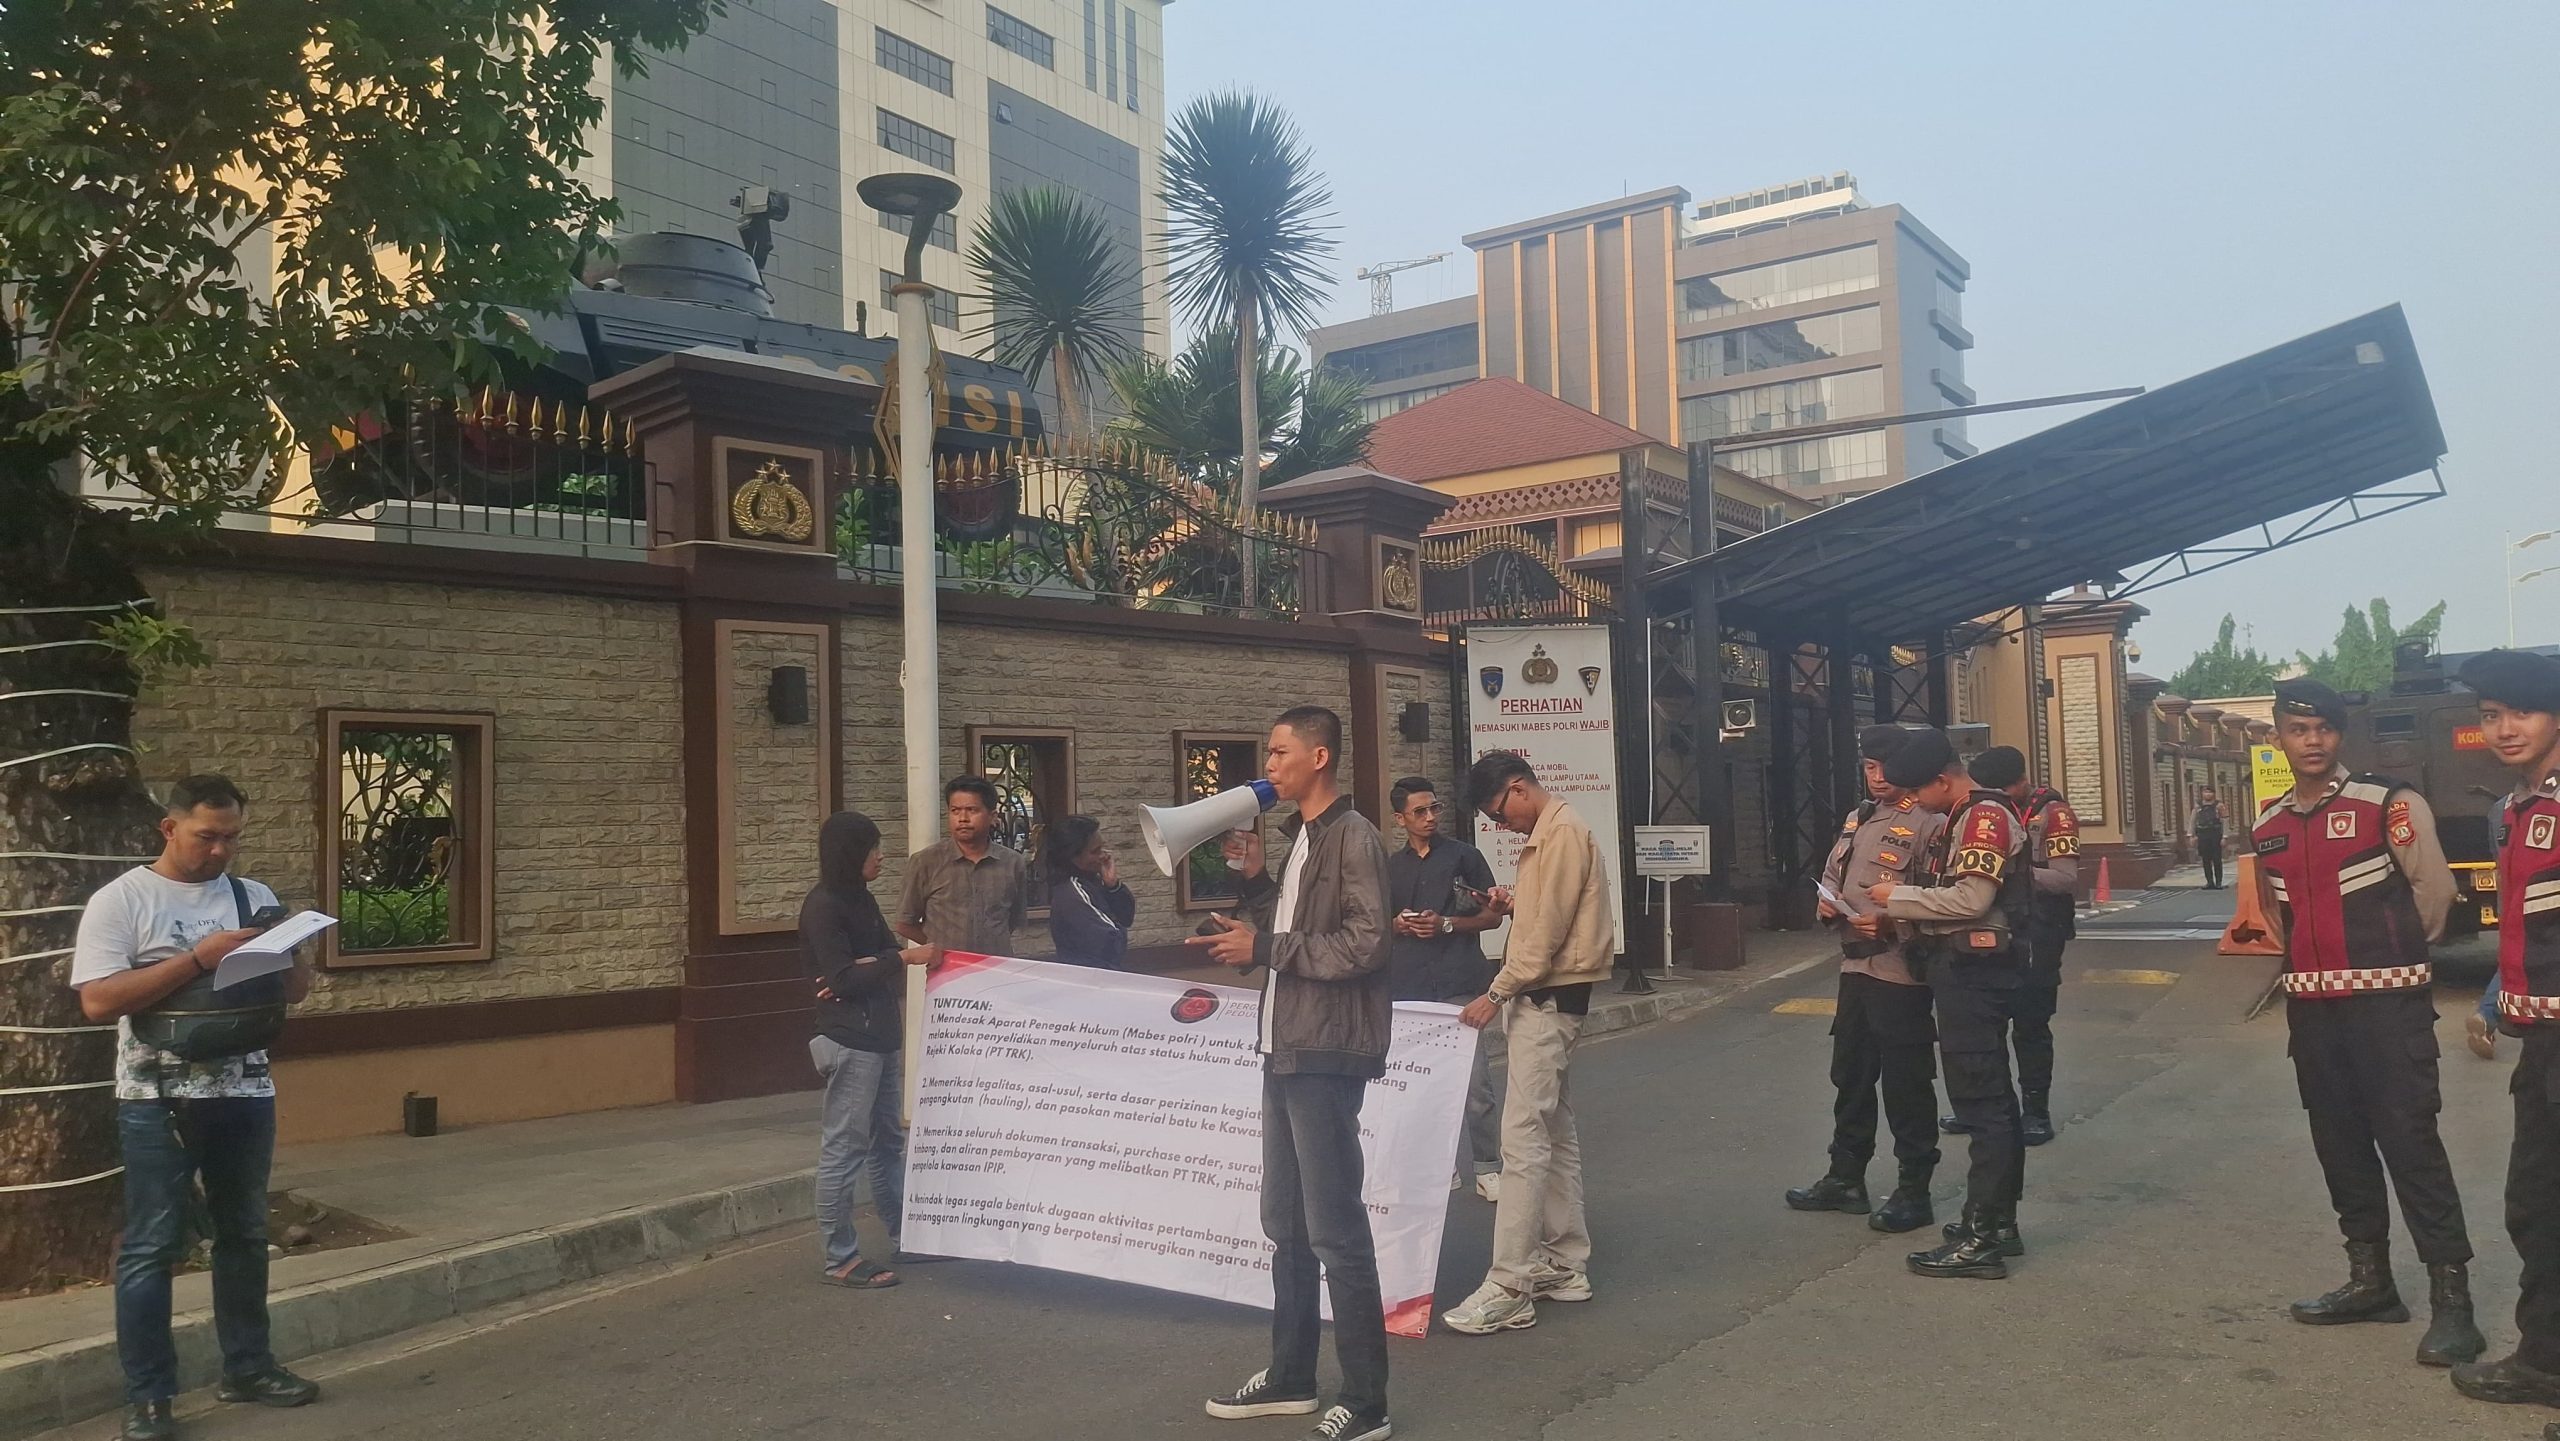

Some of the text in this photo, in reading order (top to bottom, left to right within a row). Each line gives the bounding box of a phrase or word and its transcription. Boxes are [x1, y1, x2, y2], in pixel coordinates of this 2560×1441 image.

[1501, 698, 1583, 713] PERHATIAN
[1474, 720, 1609, 733] MEMASUKI MABES POLRI WAJIB
[2458, 732, 2486, 744] KOR
[1561, 784, 1584, 792] LAMPU
[1481, 823, 1491, 832] 2.
[1881, 835, 1911, 850] POLRI
[933, 998, 993, 1012] TUNTUTAN:
[1224, 1009, 1257, 1018] PEDUL
[1230, 1001, 1259, 1010] PERG
[926, 1044, 1035, 1062] Rejeki Kolaka (PT TRK).
[928, 1028, 975, 1041] melakukan
[976, 1030, 1047, 1046] penyelidikan
[1049, 1038, 1118, 1053] menyeluruh
[1121, 1043, 1146, 1056] atas
[1149, 1047, 1186, 1060] status
[1188, 1052, 1231, 1066] hukum
[1234, 1055, 1259, 1068] dan
[936, 1014, 986, 1026] Mendesak
[987, 1016, 1027, 1029] Aparat
[1028, 1018, 1077, 1034] Penegak
[1078, 1022, 1120, 1037] Hukum
[1122, 1026, 1166, 1042] (Mabes
[1167, 1033, 1199, 1045] polri
[1208, 1038, 1245, 1050] untuk
[1405, 1061, 1431, 1076] dan
[928, 1075, 974, 1088] Memeriksa
[975, 1077, 1025, 1093] legalitas,
[1028, 1083, 1083, 1099] asal-usul,
[1086, 1090, 1118, 1102] serta
[1120, 1092, 1157, 1106] dasar
[1157, 1098, 1218, 1115] perizinan
[1220, 1103, 1263, 1121] kegiat
[919, 1093, 1263, 1139] pengangkutan (hauling), dan pasokan material batu ke Kawas
[922, 1125, 964, 1138] Memeriksa
[964, 1126, 1003, 1140] seluruh
[1005, 1129, 1058, 1146] dokumen
[1060, 1136, 1121, 1156] transaksi,
[1123, 1147, 1181, 1163] purchase
[1184, 1153, 1224, 1170] order,
[1227, 1160, 1263, 1175] surat
[912, 1158, 1007, 1175] pengelola kawasan IPIP.
[913, 1143, 939, 1156] timbang,
[940, 1142, 957, 1154] dan
[958, 1143, 988, 1156] aliran
[989, 1146, 1062, 1164] pembayaran
[1065, 1155, 1096, 1171] yang
[1098, 1158, 1170, 1179] melibatkan
[1172, 1168, 1190, 1182] PT
[1190, 1171, 1221, 1188] TRK,
[1223, 1177, 1263, 1194] pihak
[914, 1192, 944, 1206] Menindak
[945, 1195, 968, 1209] tegas
[969, 1196, 1004, 1211] segala
[1005, 1199, 1046, 1215] bentuk
[1047, 1204, 1096, 1222] dugaan
[1098, 1212, 1155, 1232] aktivitas
[1156, 1223, 1258, 1250] pertambangan
[961, 1212, 1020, 1232] lingkungan
[1021, 1220, 1051, 1237] yang
[1053, 1223, 1123, 1246] berpotensi
[1124, 1237, 1196, 1259] merugikan
[1199, 1250, 1249, 1267] negara
[1252, 1257, 1272, 1272] da
